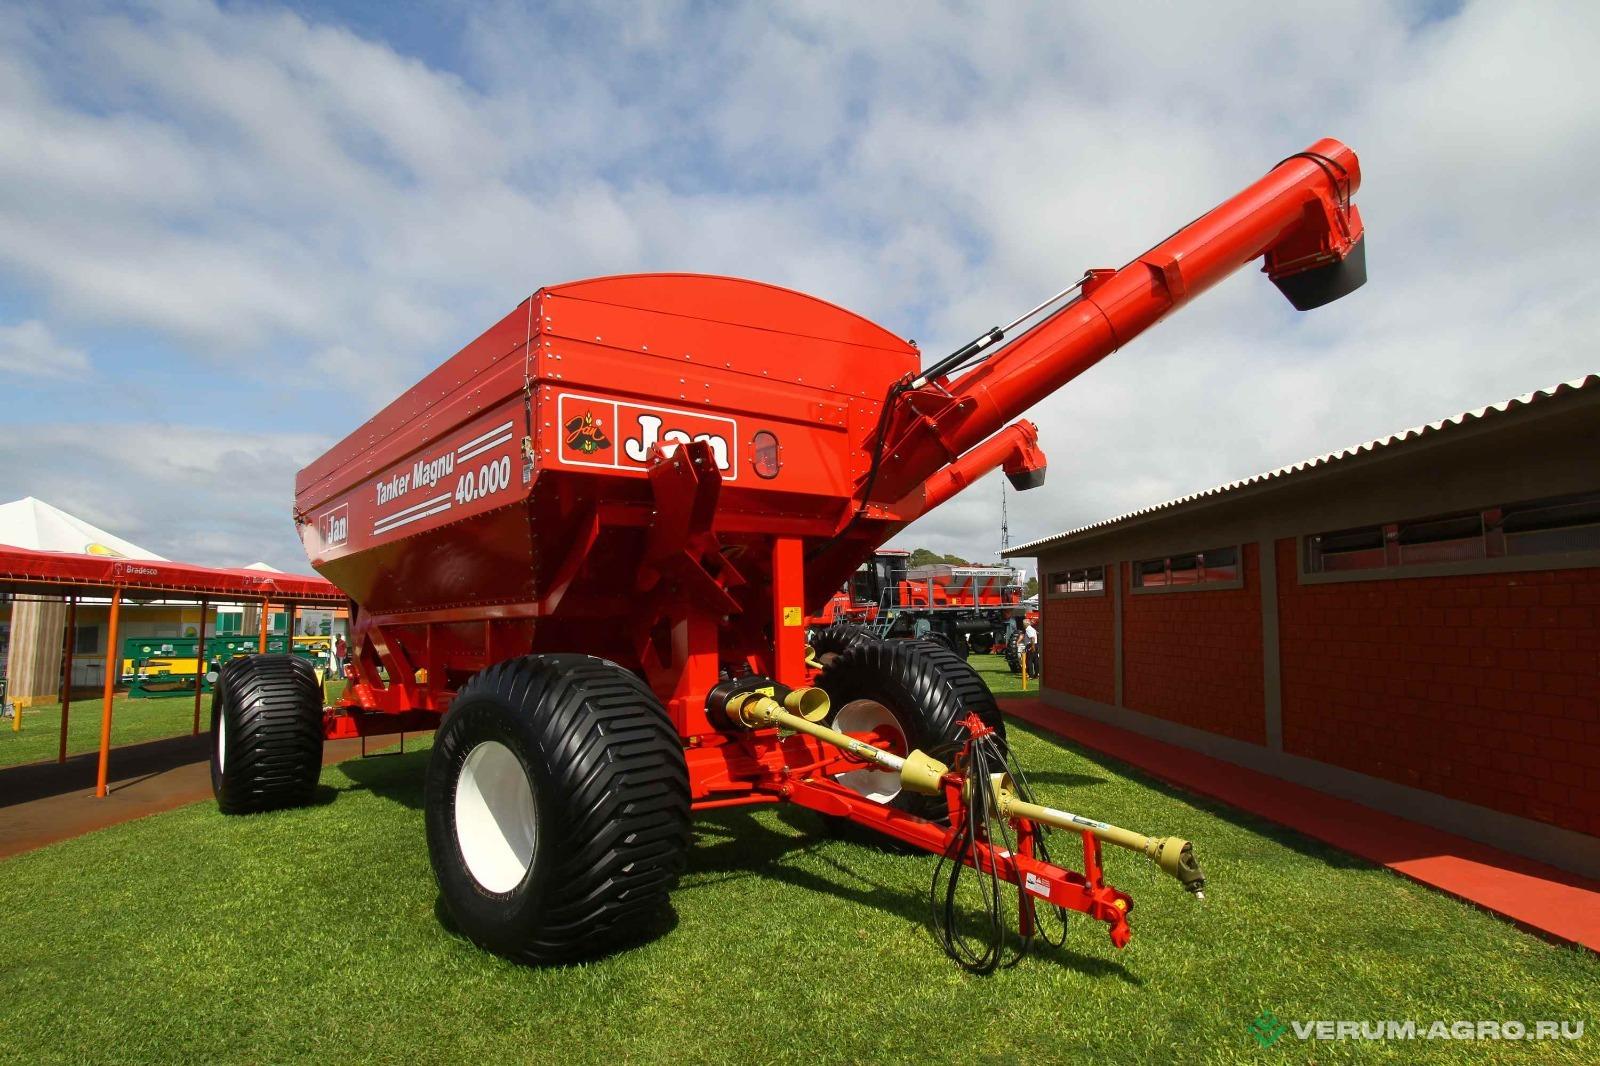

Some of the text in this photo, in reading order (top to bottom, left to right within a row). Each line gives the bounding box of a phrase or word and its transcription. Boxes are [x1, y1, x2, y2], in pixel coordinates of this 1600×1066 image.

[564, 415, 607, 444] Jan
[376, 452, 455, 506] Tanker Magnu
[455, 455, 511, 505] 40.000
[327, 515, 347, 545] Jan
[126, 565, 157, 575] Bradesco
